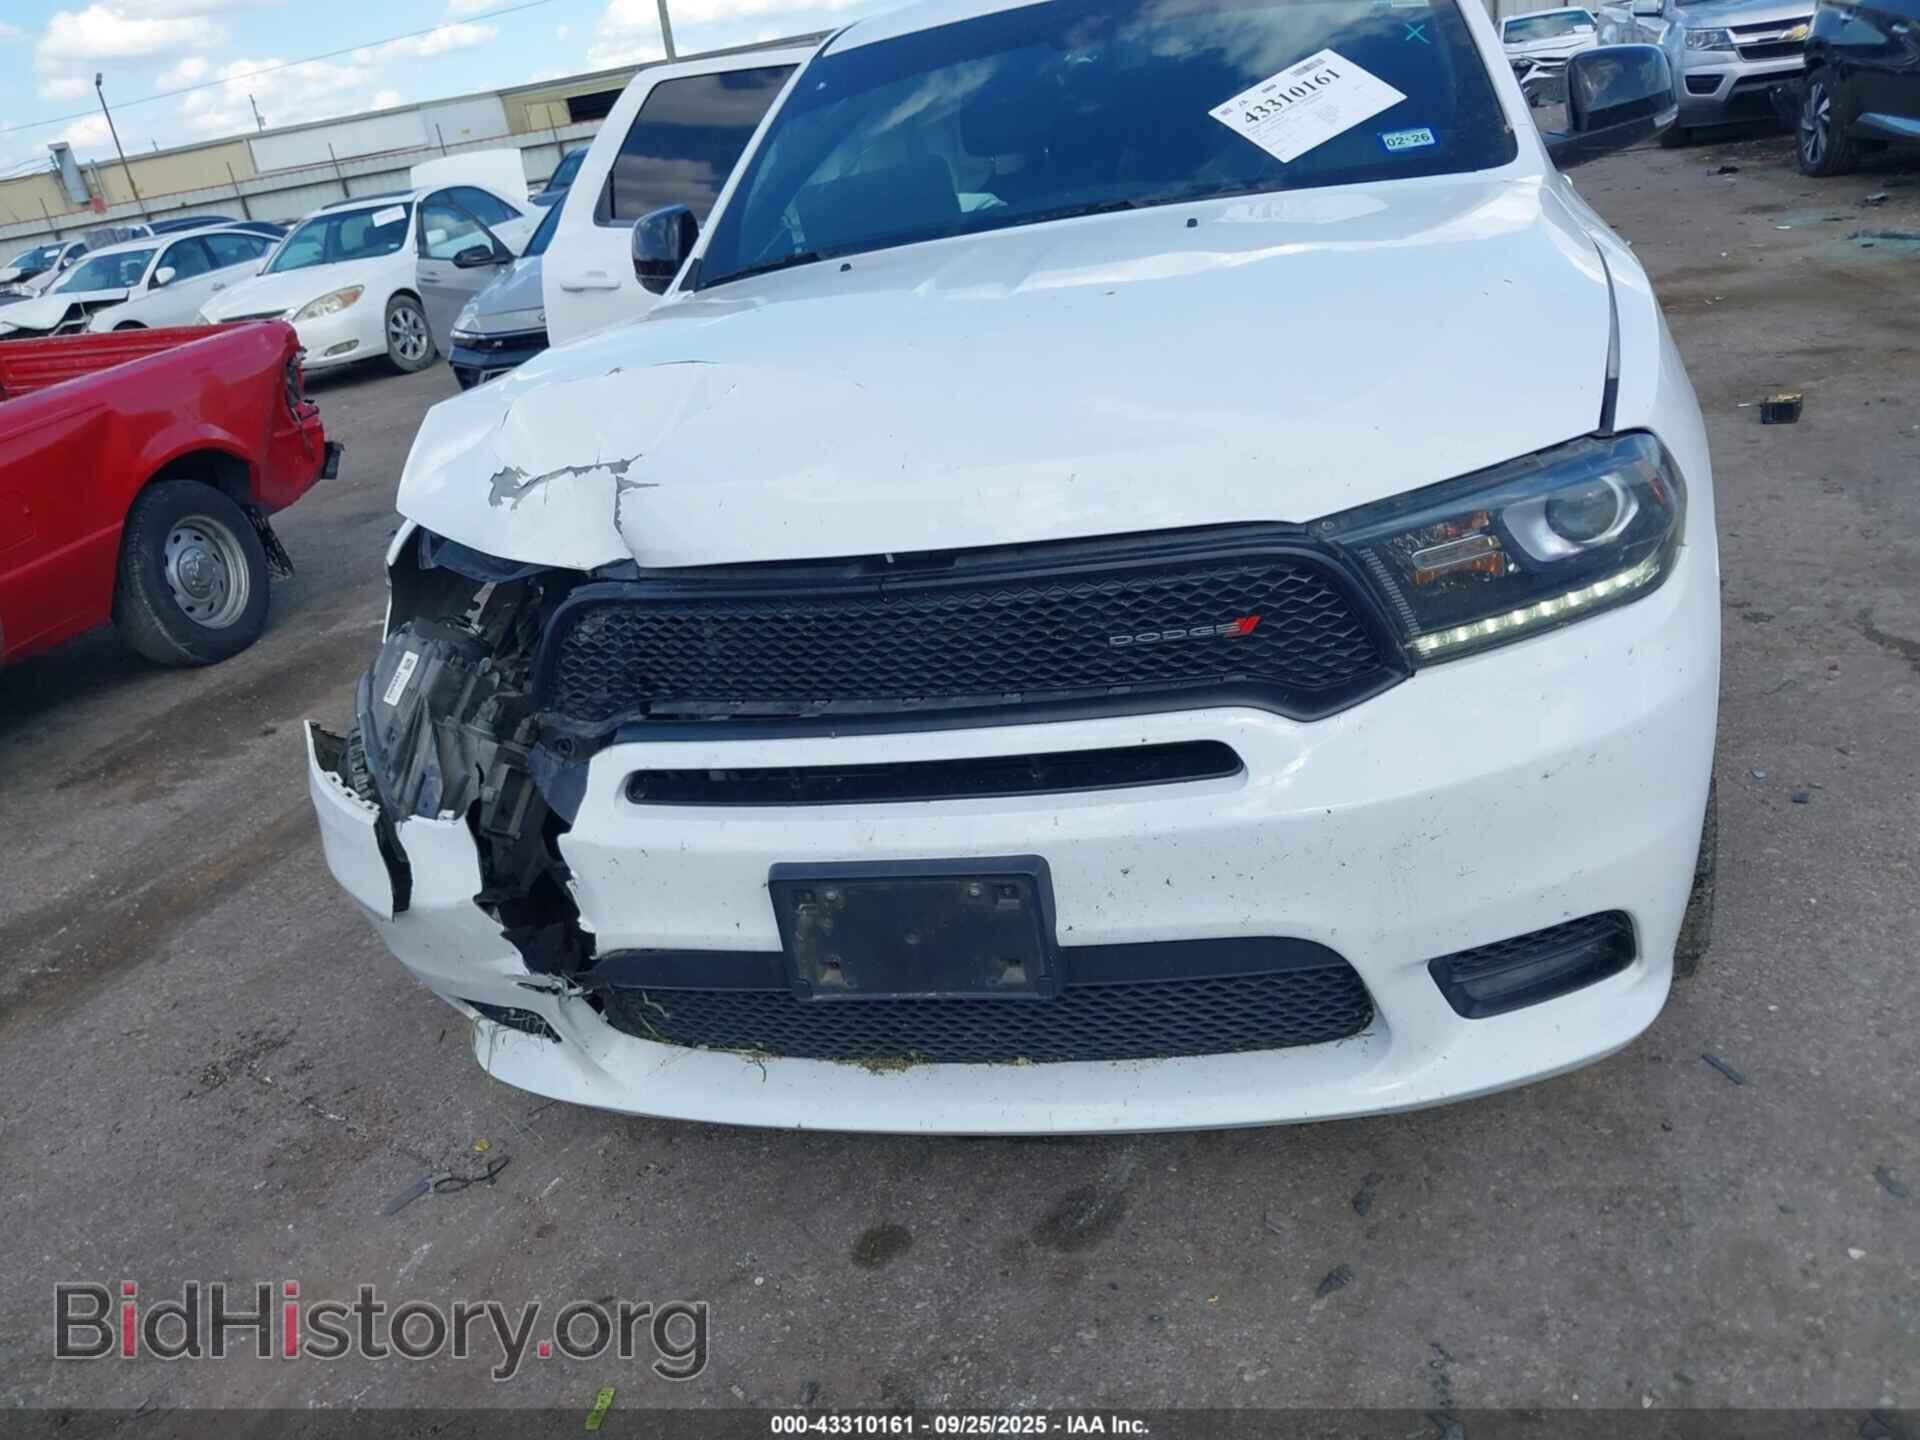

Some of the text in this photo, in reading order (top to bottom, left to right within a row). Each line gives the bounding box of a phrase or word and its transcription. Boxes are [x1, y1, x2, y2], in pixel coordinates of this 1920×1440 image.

[1244, 68, 1341, 123] 43310161
[1386, 133, 1430, 147] 02-26
[1109, 622, 1241, 645] DODGE
